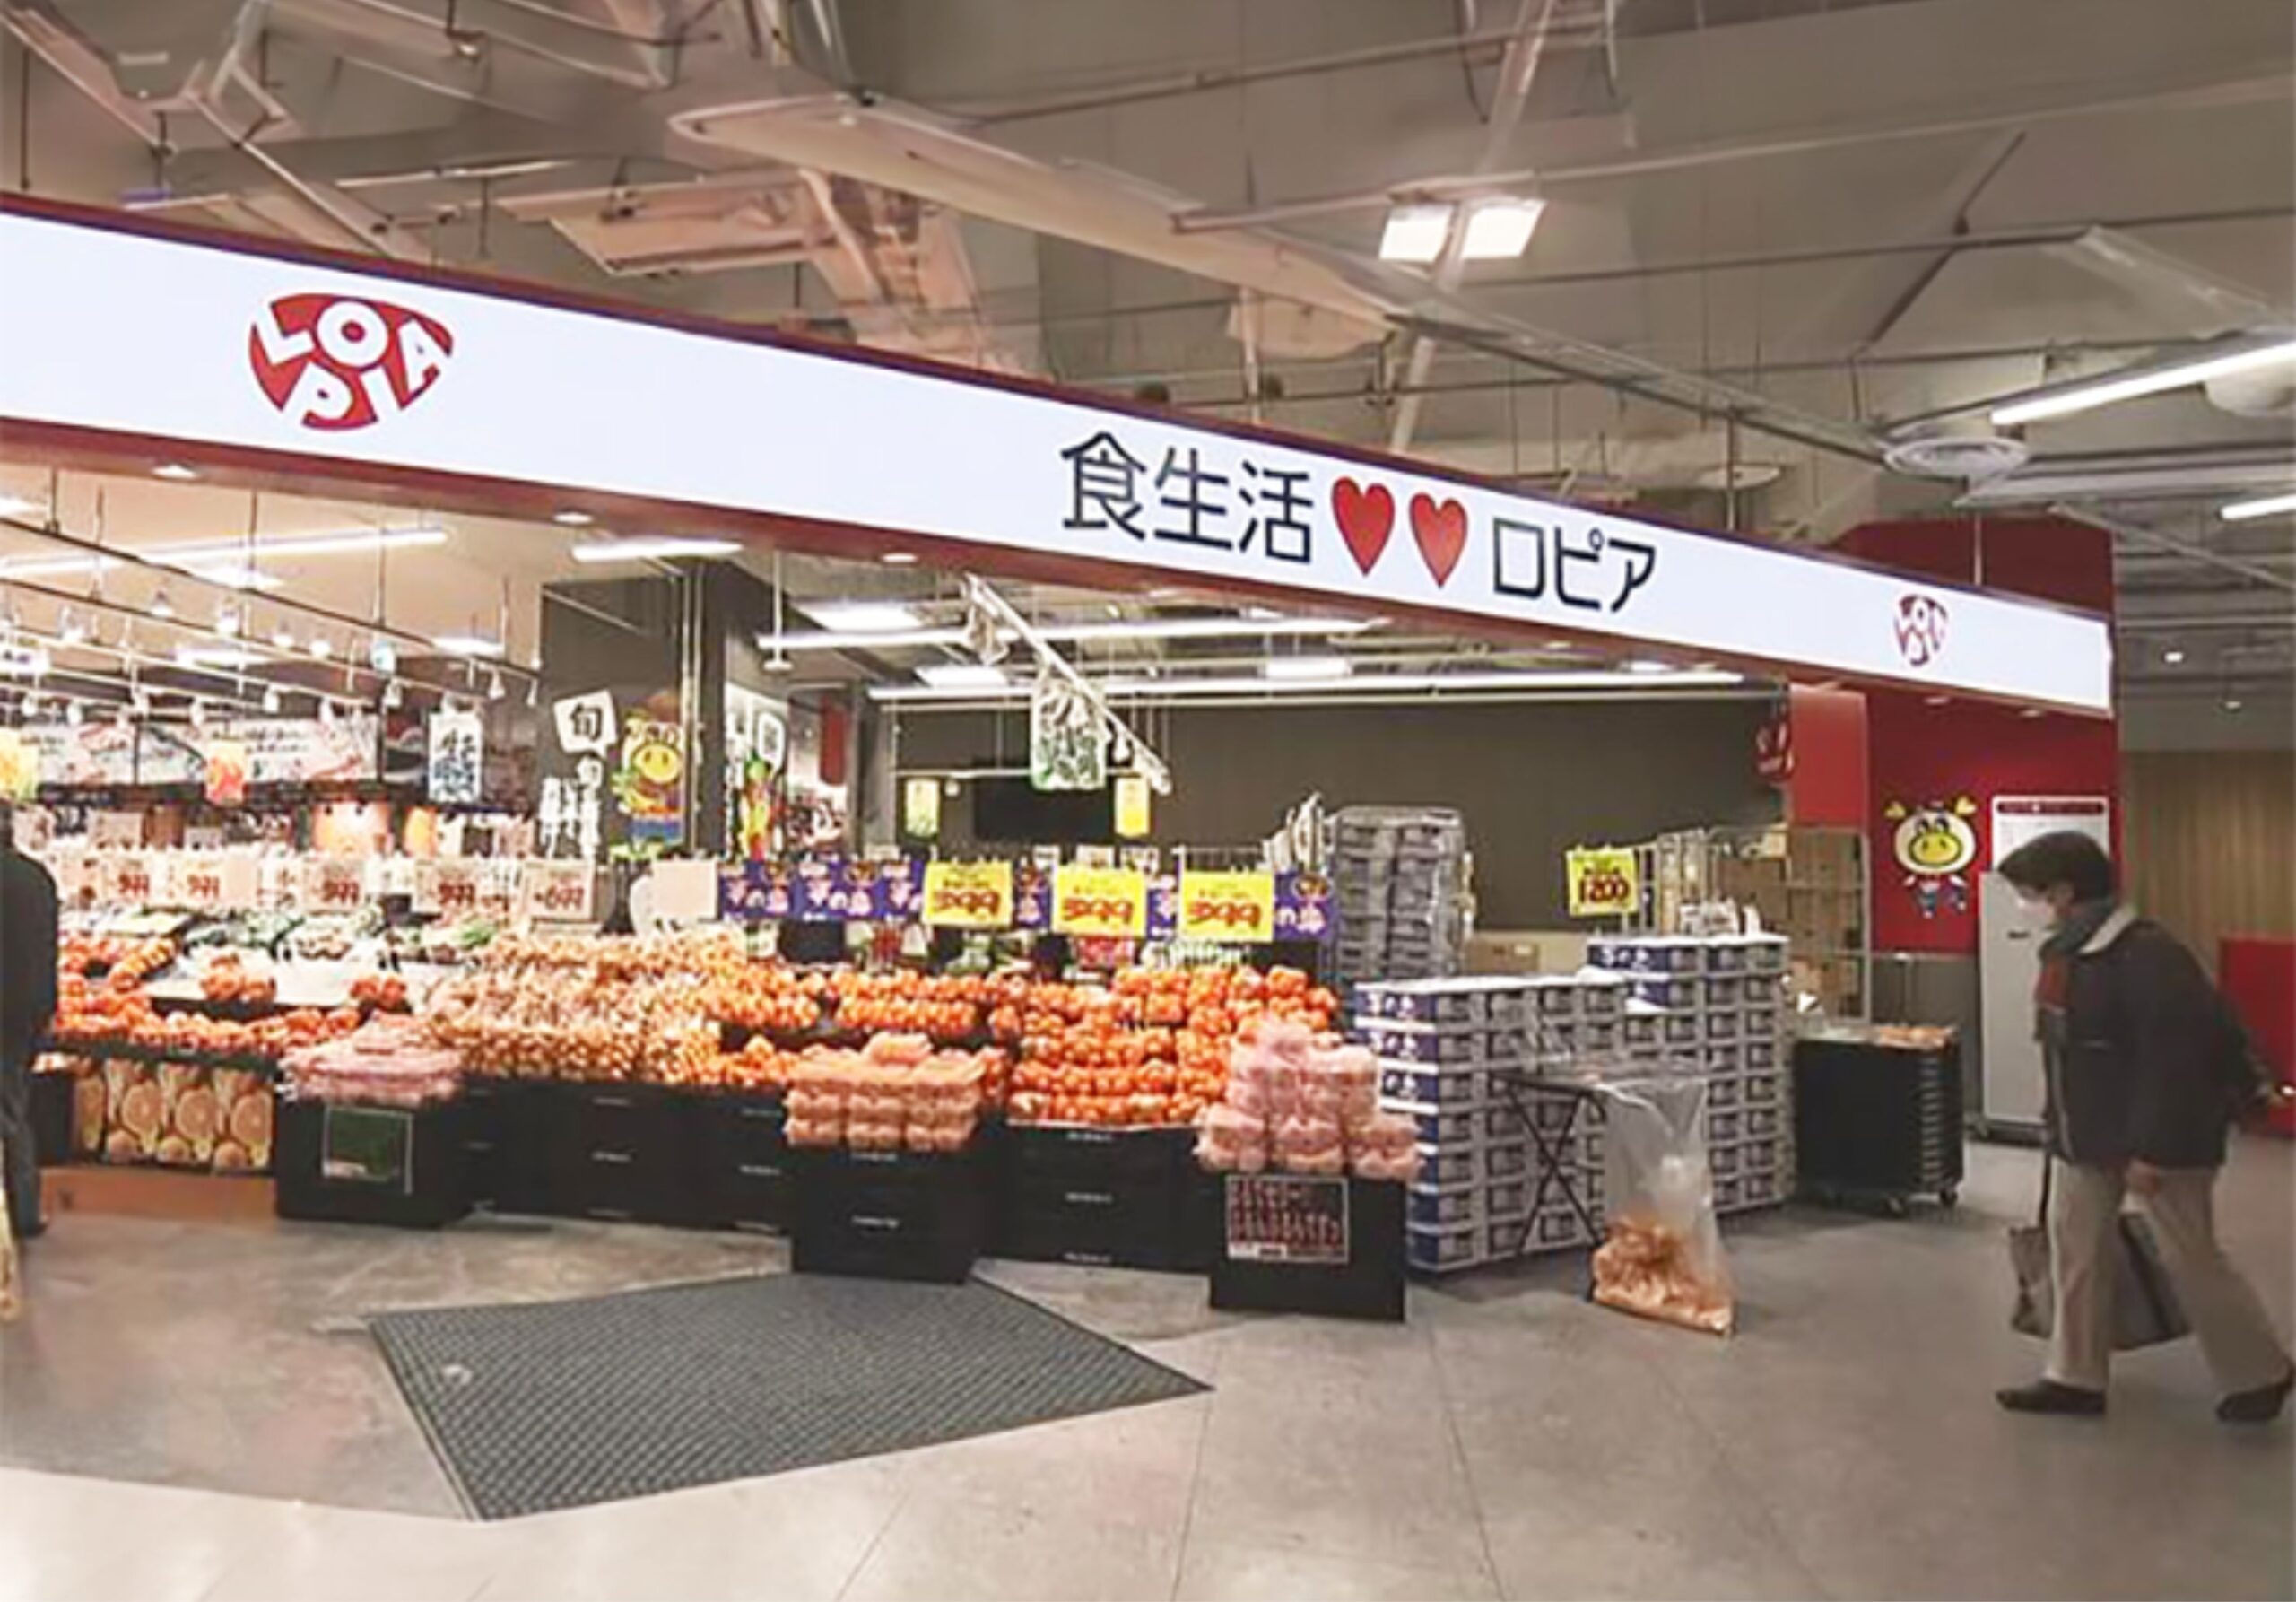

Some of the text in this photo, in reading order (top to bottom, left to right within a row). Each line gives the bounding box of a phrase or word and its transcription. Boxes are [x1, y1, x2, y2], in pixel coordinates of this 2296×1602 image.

[1060, 431, 1657, 613] 食生活 ロピア
